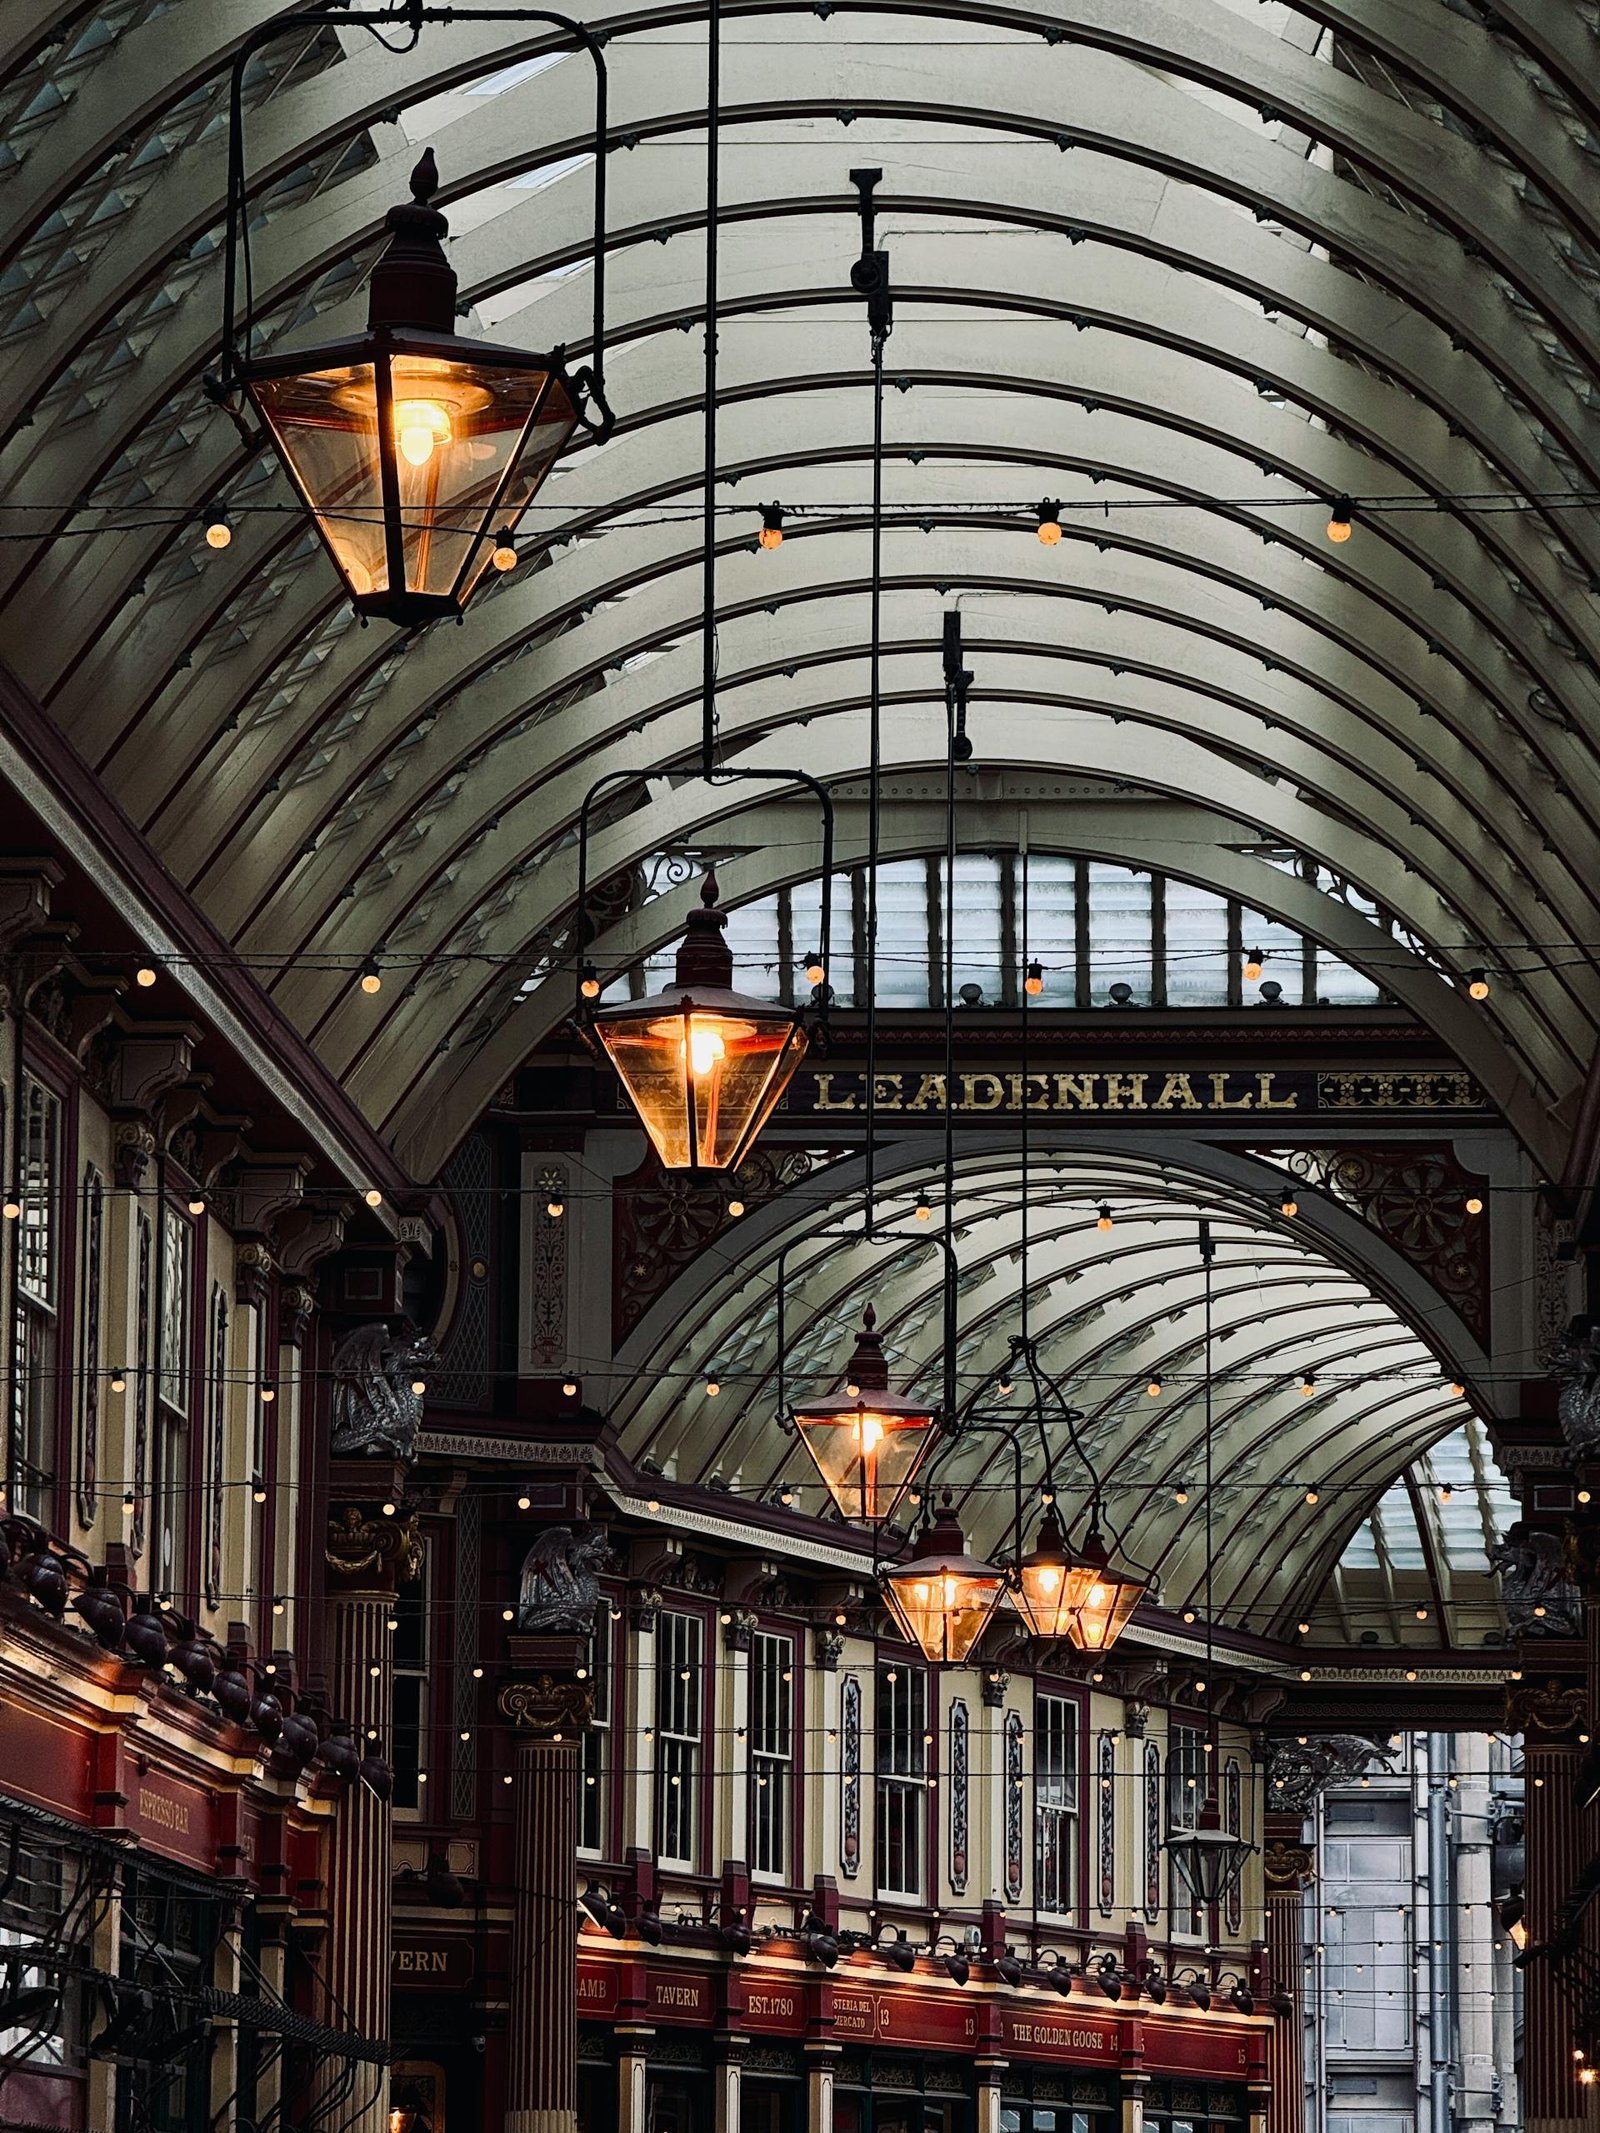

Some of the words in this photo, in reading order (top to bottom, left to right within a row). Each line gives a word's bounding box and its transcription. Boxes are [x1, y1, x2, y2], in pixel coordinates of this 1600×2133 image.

[813, 1073, 1298, 1110] LEADENHALL
[140, 1788, 173, 1829] ESPRESSO
[175, 1804, 189, 1834] BAR
[576, 1978, 607, 1998] AMB
[656, 1985, 699, 2007] TAVERN
[748, 1995, 794, 2016] EST.1780
[832, 1998, 858, 2011] STERIA
[859, 2001, 871, 2013] DEL
[880, 2009, 890, 2026] 13
[965, 2018, 974, 2036] 13
[1012, 2023, 1032, 2042] THE
[1033, 2027, 1071, 2046] GOLDEN
[1073, 2030, 1103, 2049] GOOSE
[1110, 2034, 1118, 2051] 14
[1238, 2048, 1246, 2064] 15
